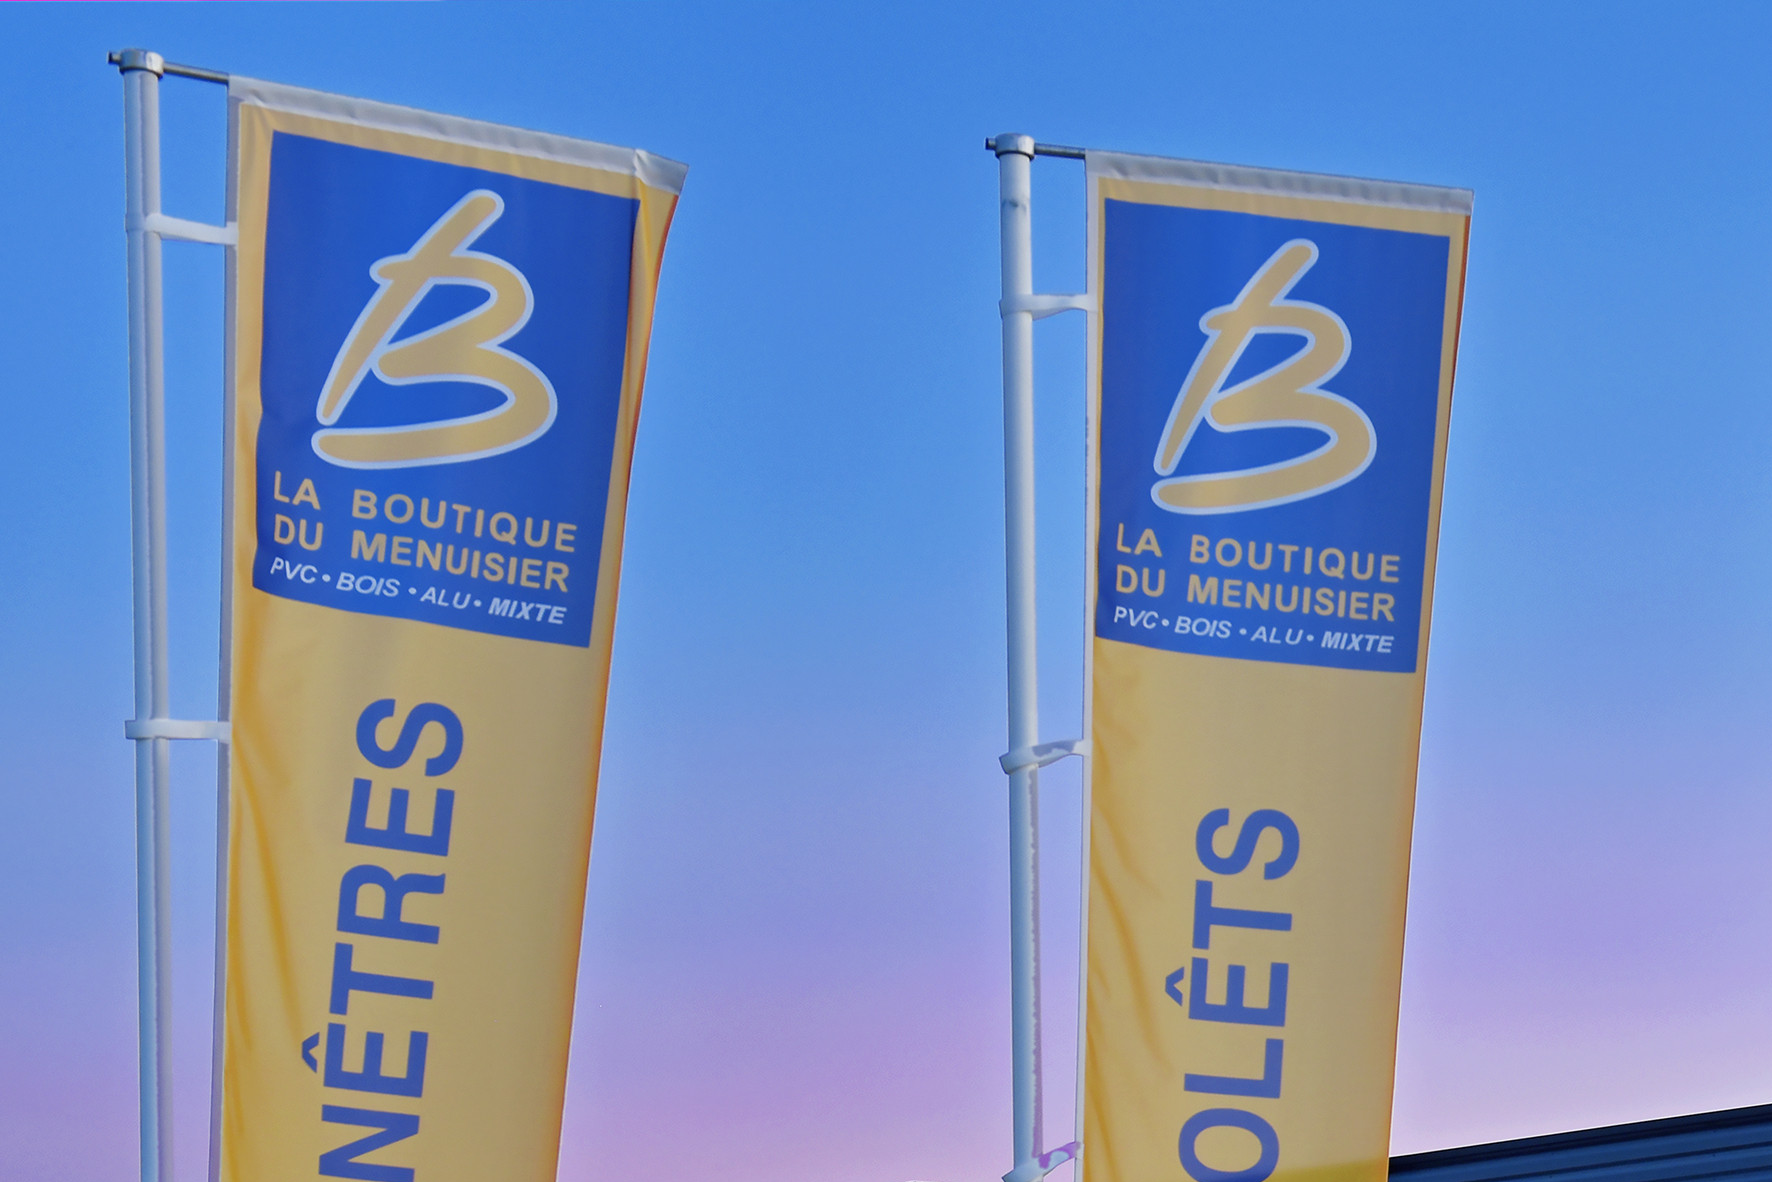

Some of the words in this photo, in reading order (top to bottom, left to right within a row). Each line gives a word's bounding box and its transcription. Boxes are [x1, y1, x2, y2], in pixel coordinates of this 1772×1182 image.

[273, 471, 321, 510] LA
[352, 489, 578, 553] BOUTIQUE
[273, 514, 324, 552] DU
[351, 530, 570, 592] MENUISIER
[1116, 522, 1163, 558] LA
[1190, 534, 1400, 583] BOUTIQUE
[270, 557, 318, 585] PVC
[336, 572, 401, 598] BOIS
[419, 586, 473, 610] ALU
[488, 596, 567, 624] MIXTE
[1116, 564, 1165, 598] DU
[1187, 574, 1395, 622] MENUISIER
[1114, 606, 1159, 630] PVC
[1174, 615, 1232, 639] BOIS
[1251, 624, 1303, 646] ALU
[1321, 631, 1395, 654] MIXTE
